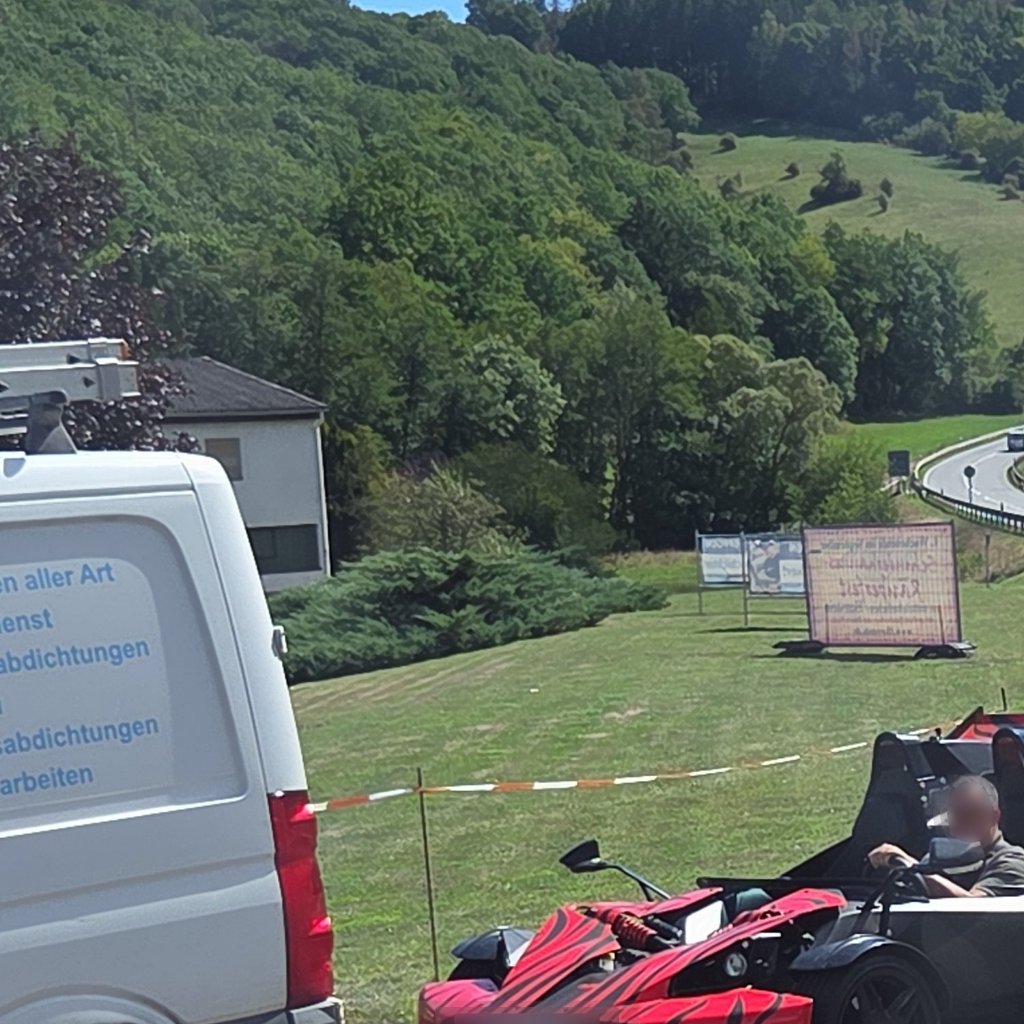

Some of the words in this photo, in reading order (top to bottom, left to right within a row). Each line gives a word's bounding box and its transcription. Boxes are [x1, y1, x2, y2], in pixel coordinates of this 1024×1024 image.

[24, 567, 74, 591] aller
[80, 562, 115, 586] Art
[0, 608, 54, 634] enst
[0, 717, 159, 756] abdichtungen
[1, 766, 94, 796] arbeiten
